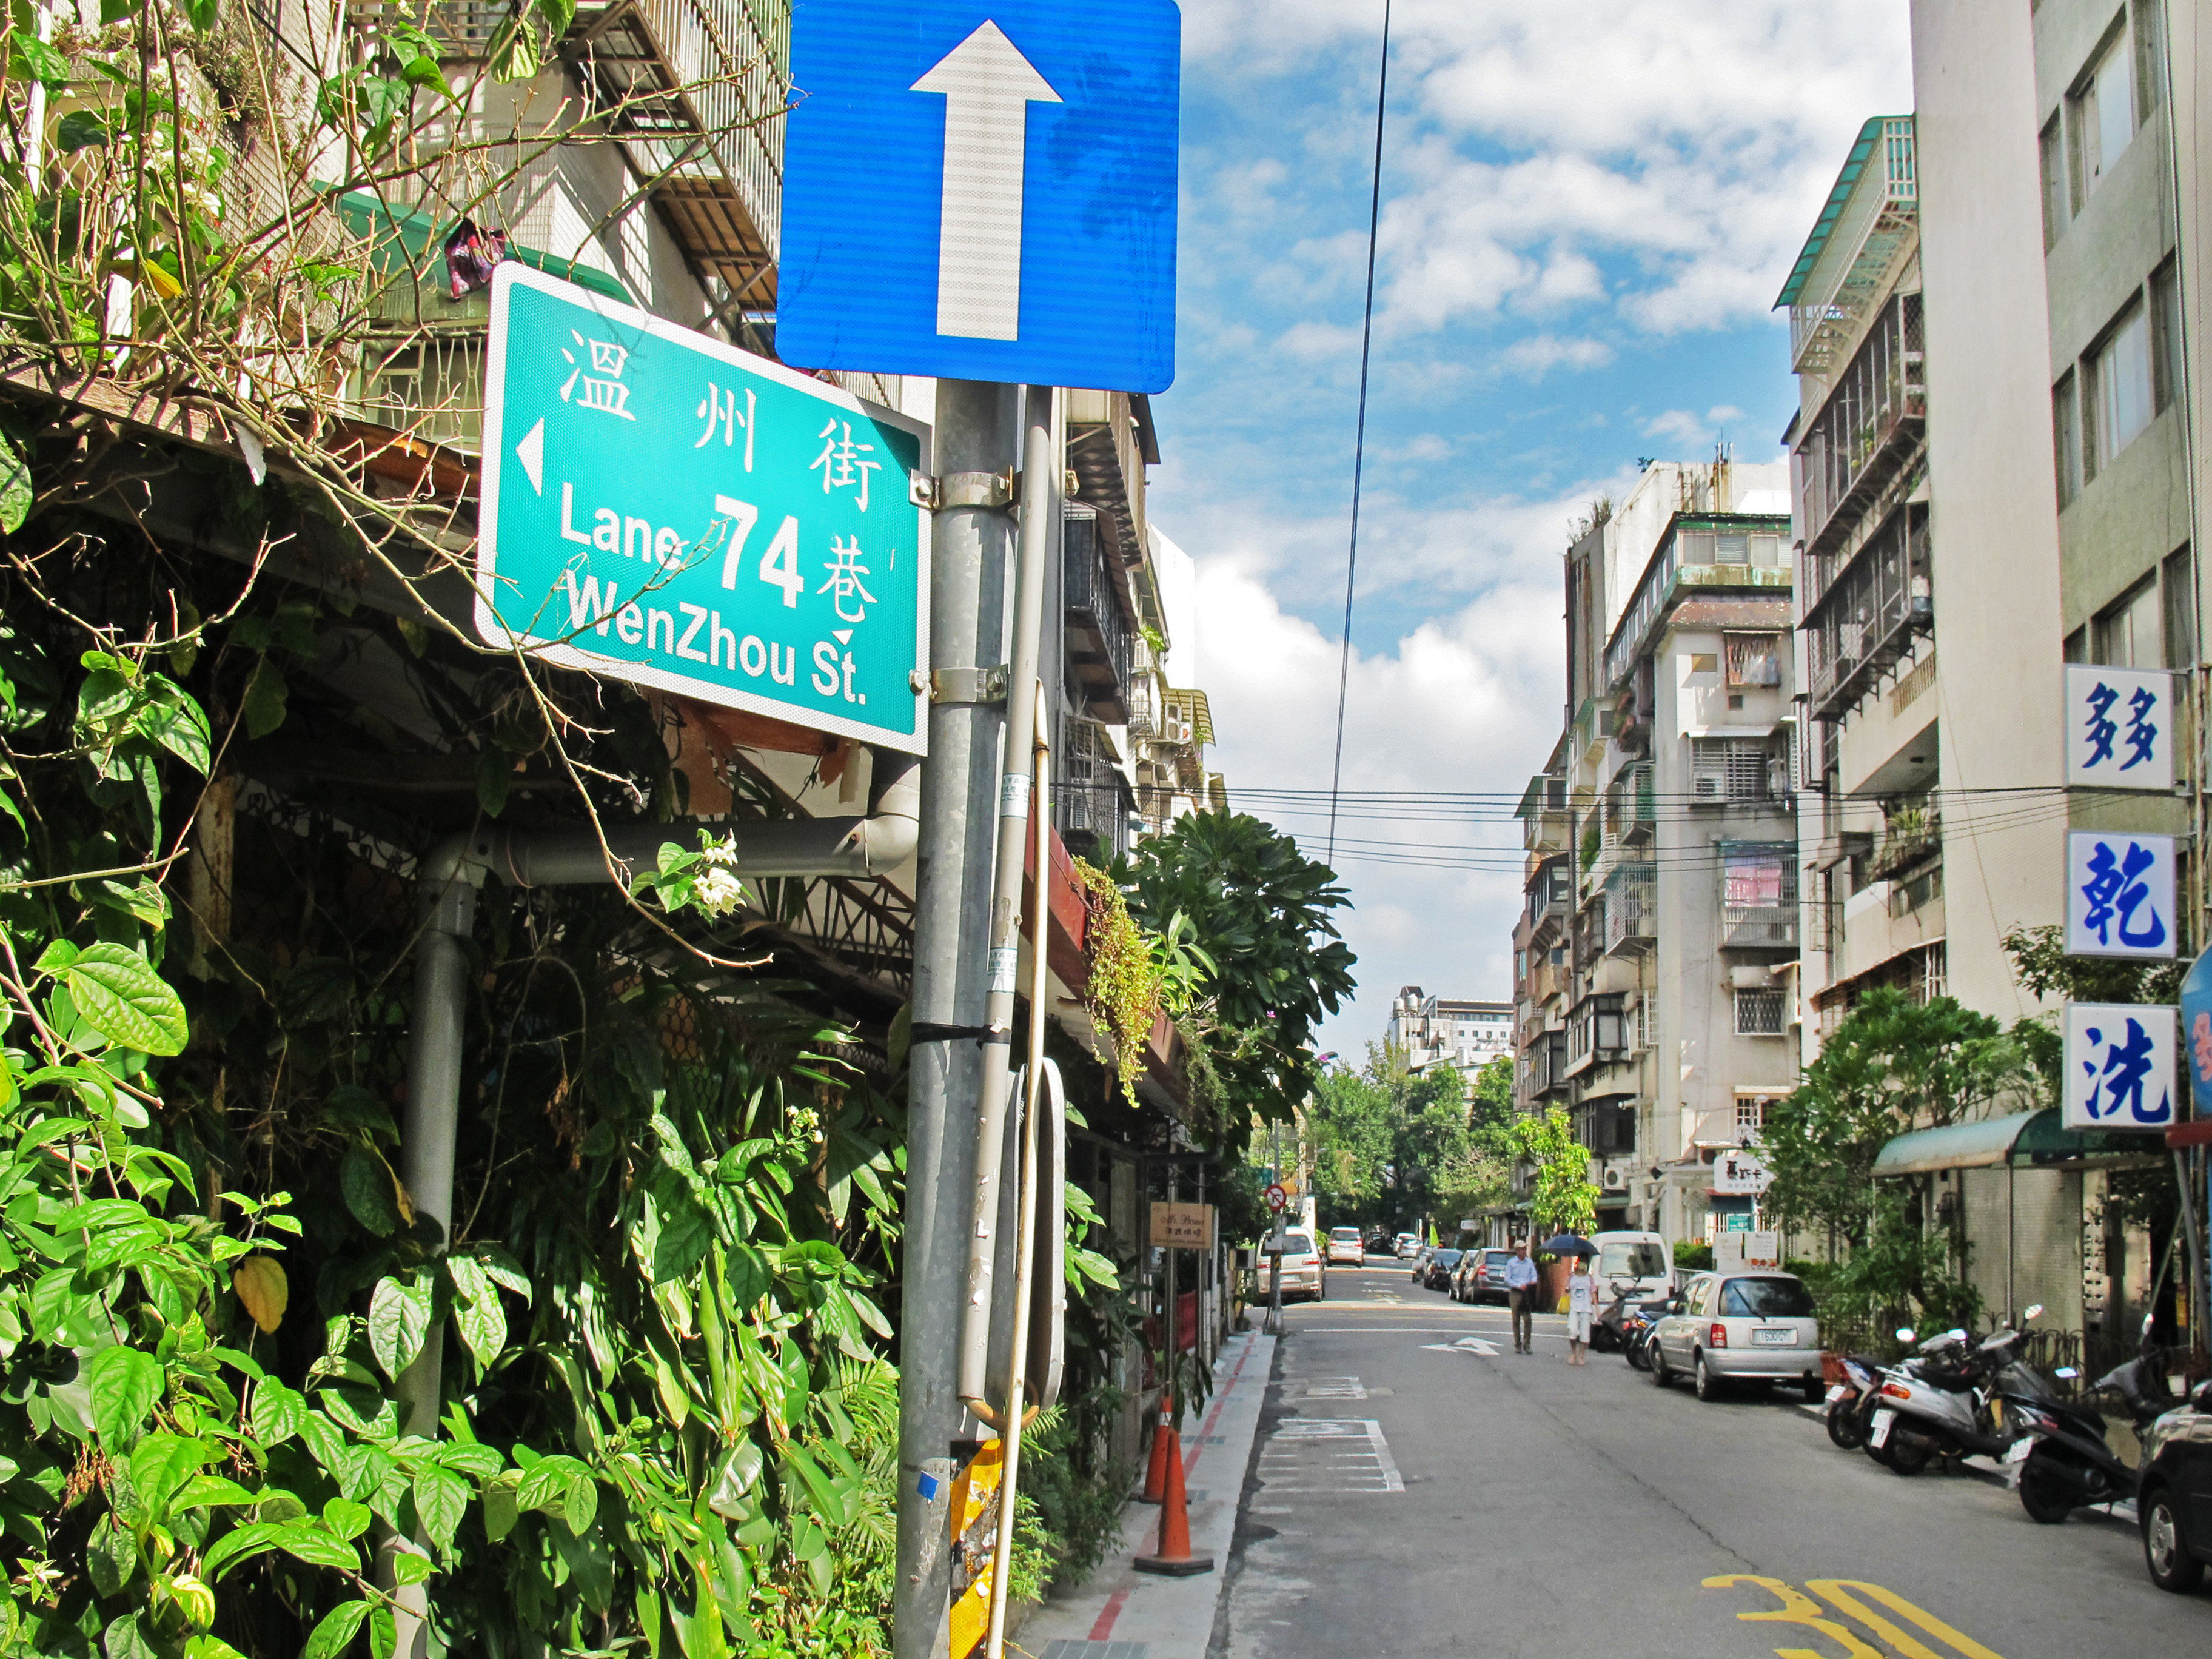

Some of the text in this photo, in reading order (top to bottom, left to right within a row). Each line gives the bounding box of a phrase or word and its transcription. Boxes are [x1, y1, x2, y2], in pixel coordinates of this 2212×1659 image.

[558, 329, 882, 513] 溫州街
[560, 482, 684, 571] Lane
[565, 568, 867, 705] WenZhou St.
[1700, 1575, 2006, 1659] 30
